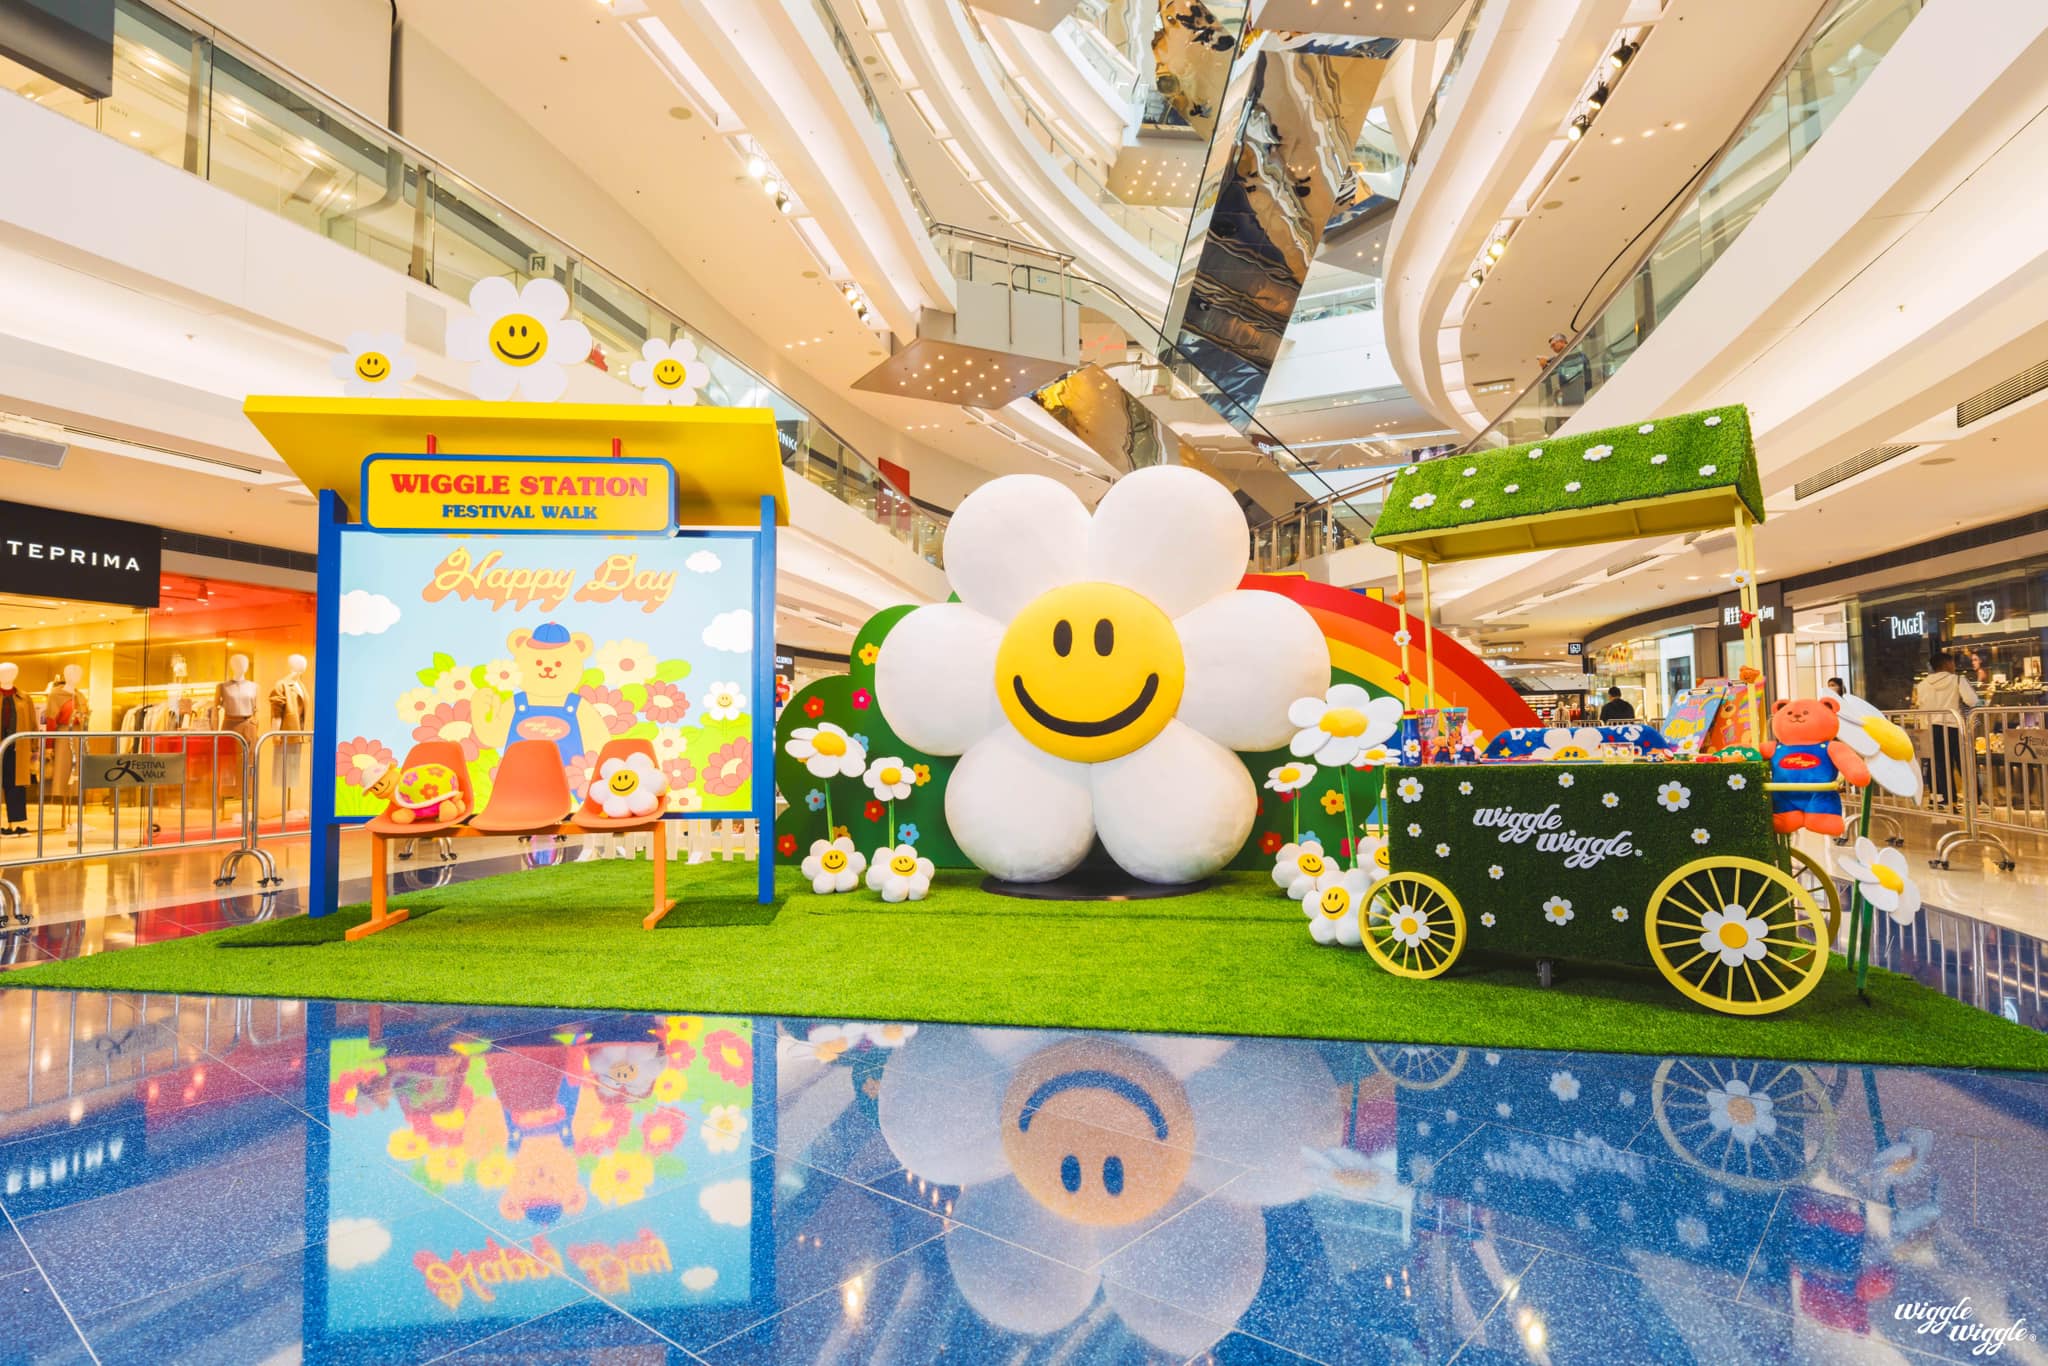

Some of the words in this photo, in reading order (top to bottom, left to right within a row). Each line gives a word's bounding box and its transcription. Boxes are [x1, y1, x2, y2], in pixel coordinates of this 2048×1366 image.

[390, 474, 510, 495] WIGGLE
[519, 475, 648, 497] STATION
[442, 504, 535, 519] FESTIVAL
[541, 505, 598, 520] WALK
[7, 540, 140, 571] TEPRIMA
[428, 545, 576, 607] Happy
[579, 553, 678, 608] Day
[1890, 611, 1926, 639] PIAGET
[1472, 804, 1563, 843] wiggle
